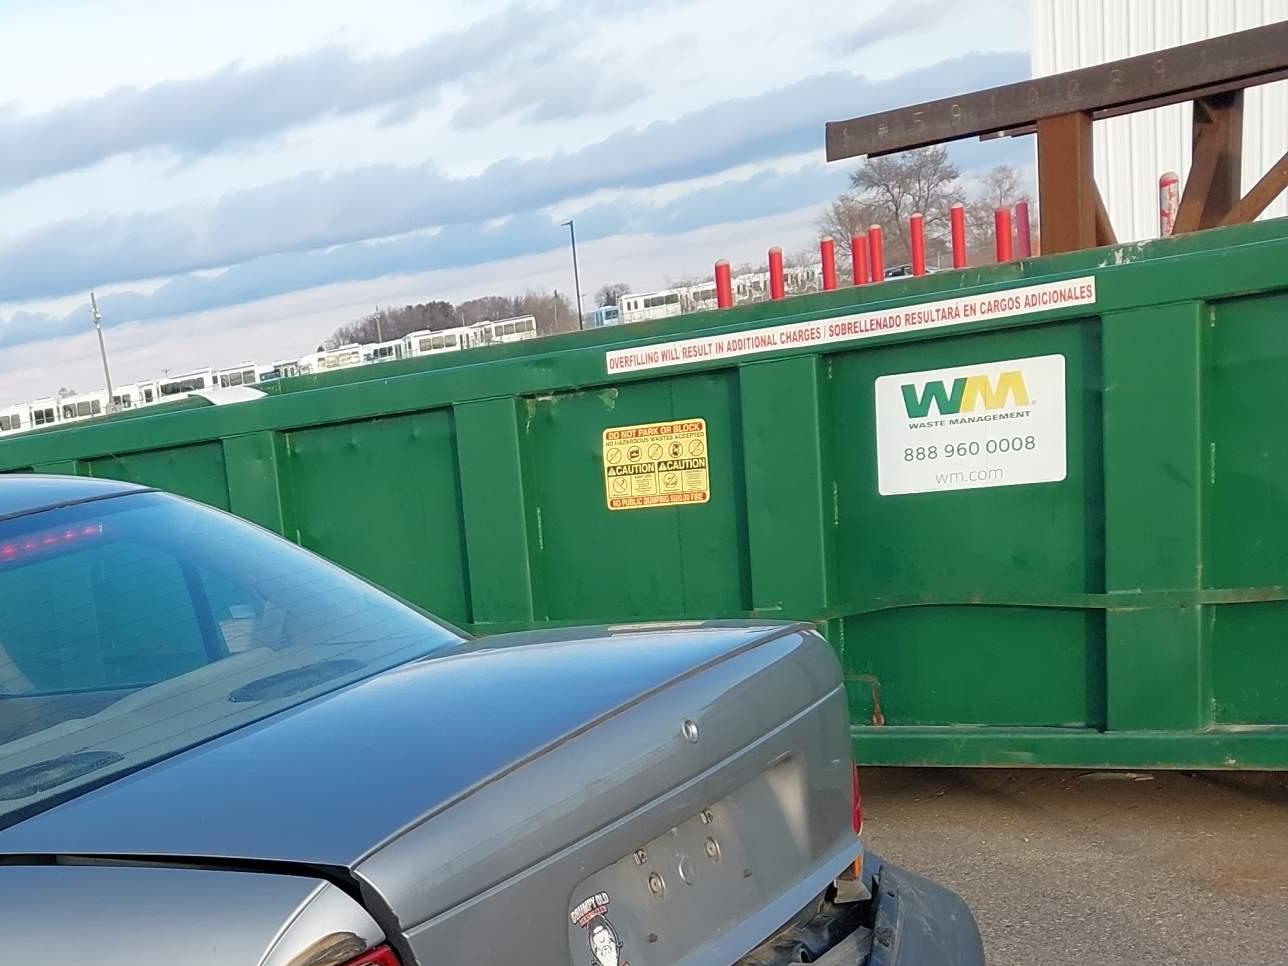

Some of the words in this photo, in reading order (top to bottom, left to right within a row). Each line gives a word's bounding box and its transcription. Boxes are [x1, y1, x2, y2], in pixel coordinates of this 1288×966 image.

[609, 353, 659, 370] OVERFILLING
[661, 349, 680, 362] WILL
[682, 343, 713, 359] RESULT
[715, 342, 724, 354] IN
[726, 334, 777, 352] ADDITIONAL
[779, 327, 822, 344] CHARGES
[828, 314, 902, 338] SOBRELLENADO
[904, 303, 961, 326] RESULTARÁ
[963, 303, 976, 317] EN
[979, 295, 1021, 315] CARGOS
[1023, 284, 1093, 308] ADICIONALES
[900, 370, 1030, 419] WM
[908, 420, 946, 430] WASTE
[948, 410, 1032, 425] MANAGEMENT
[608, 431, 620, 440] DO
[620, 430, 636, 439] NOT
[638, 427, 659, 437] PARK
[659, 426, 672, 434] OR
[672, 422, 701, 434] BLOCK
[614, 438, 650, 446] HAZARDOUS
[674, 431, 705, 440] ACCEPTED
[903, 446, 938, 462] 888
[944, 441, 980, 458] 960
[985, 435, 1036, 454] 0008
[616, 463, 655, 475] CAUTION
[666, 458, 705, 470] CAUTION
[935, 468, 1004, 485] wm.com
[612, 499, 622, 507] NO
[622, 497, 643, 506] PUBLIC
[643, 495, 670, 505] DUMPING
[571, 896, 596, 924] GRUMPY
[595, 892, 610, 907] OLD
